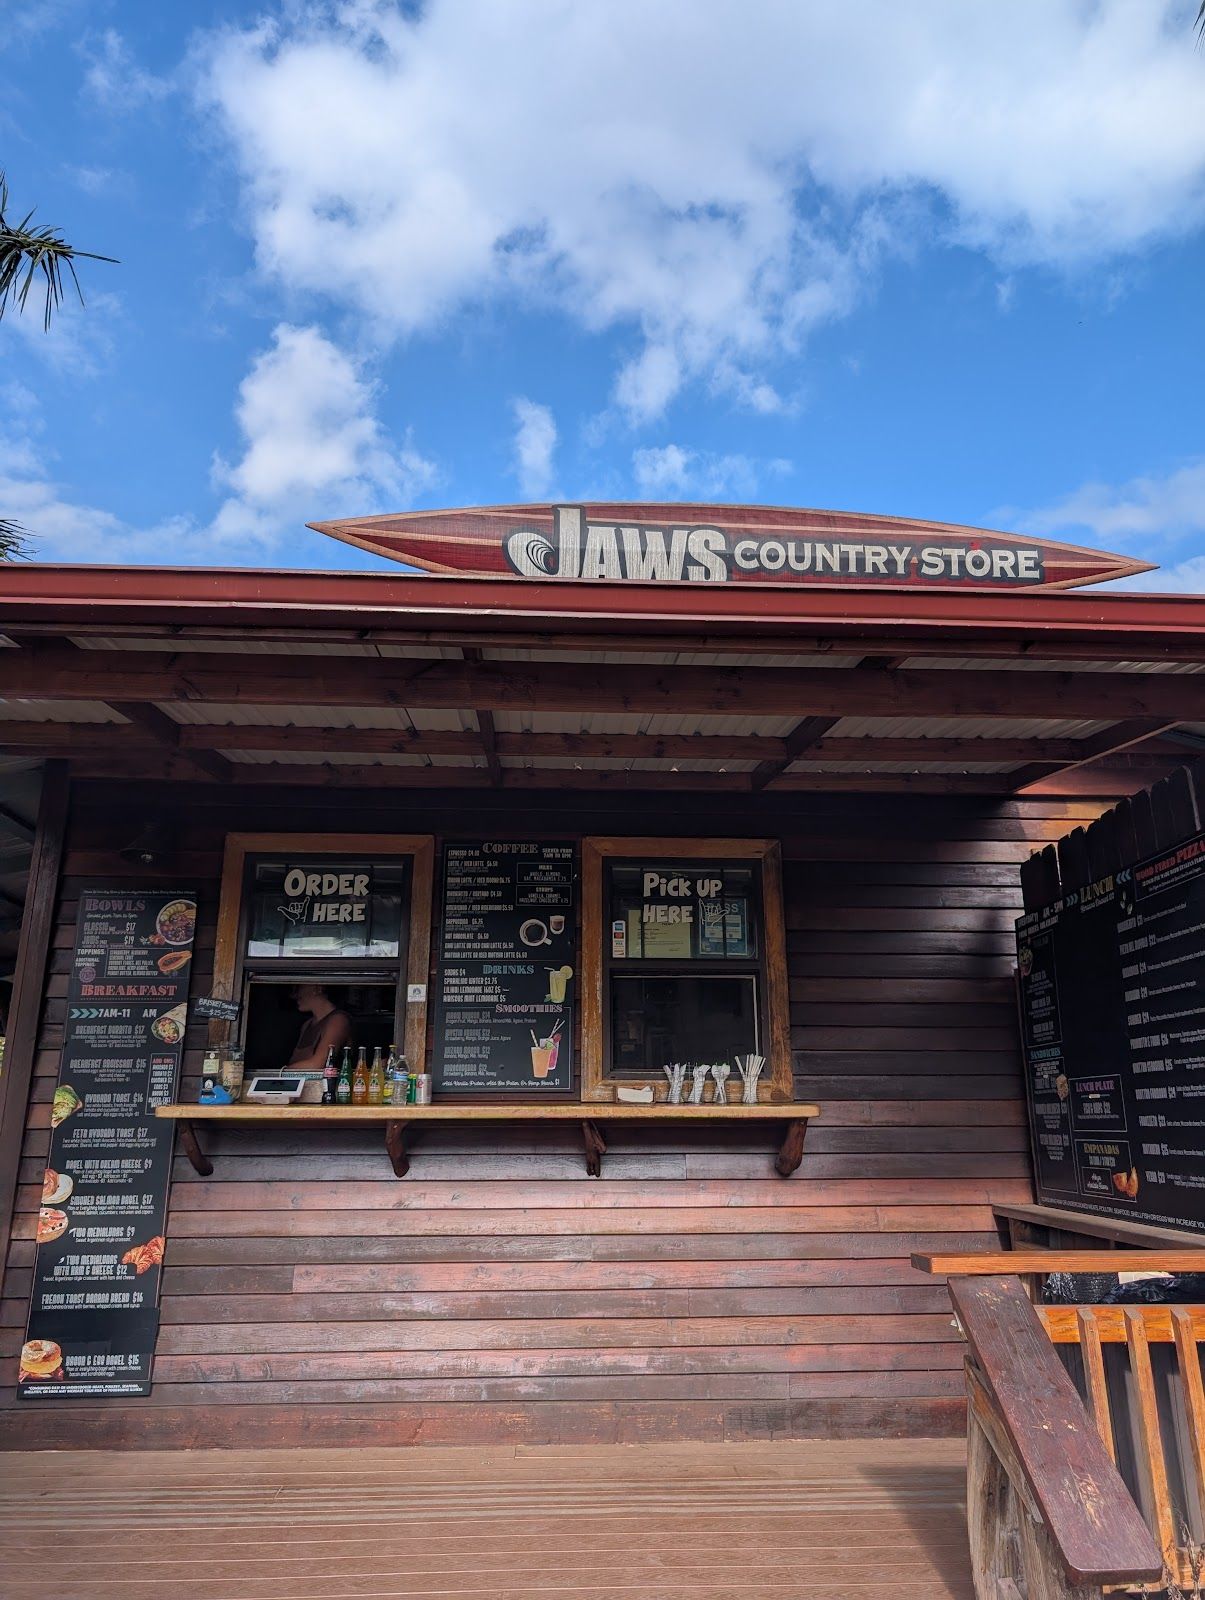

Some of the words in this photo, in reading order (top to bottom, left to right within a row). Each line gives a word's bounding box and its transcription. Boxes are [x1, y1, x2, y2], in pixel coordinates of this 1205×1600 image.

[507, 508, 727, 582] JAWS
[734, 540, 911, 574] COUNTRY
[920, 546, 1040, 579] STORE
[482, 842, 538, 853] COFFEE
[284, 868, 370, 896] ORDER
[696, 879, 722, 898] UP
[85, 898, 146, 911] BOWLS
[313, 903, 365, 922] HERE
[643, 904, 693, 923] HERE
[126, 922, 136, 932] $17
[124, 936, 134, 945] $19
[483, 965, 534, 974] DRINKS
[82, 985, 177, 996] BREAKFAST
[143, 1009, 157, 1018] AM
[496, 1004, 562, 1012] SMOOTHIES
[134, 1024, 144, 1034] $17
[85, 1094, 111, 1102] AVOCADO
[113, 1094, 130, 1102] TOAST
[133, 1093, 143, 1103] $16
[73, 1128, 87, 1138] FETA
[88, 1128, 115, 1138] AVOCADO
[116, 1128, 135, 1138] TOAST
[138, 1127, 148, 1138] $17
[66, 1160, 83, 1169] BAGEL
[85, 1160, 100, 1169] WITH
[100, 1160, 120, 1169] CREAM
[121, 1160, 142, 1169] CHEESE
[144, 1158, 152, 1169] $9
[142, 1194, 153, 1206] $17
[72, 1228, 86, 1237] TWO
[88, 1227, 124, 1237] MEDIALUNAS
[127, 1226, 136, 1237] $9
[67, 1255, 80, 1264] TWO
[81, 1255, 118, 1264] MEDIALUNAS
[54, 1266, 69, 1275] WITH
[70, 1266, 84, 1275] HAM
[92, 1266, 114, 1275] CHEESE
[116, 1264, 128, 1276] $12
[42, 1294, 65, 1304] FRENCH
[66, 1294, 85, 1304] TOAST
[86, 1294, 110, 1304] BANANA
[110, 1294, 130, 1304] BREAD
[133, 1292, 144, 1303] $16
[66, 1356, 85, 1366] BACON
[93, 1356, 104, 1366] EGG
[106, 1356, 124, 1366] BAGEL
[128, 1354, 140, 1366] $15
